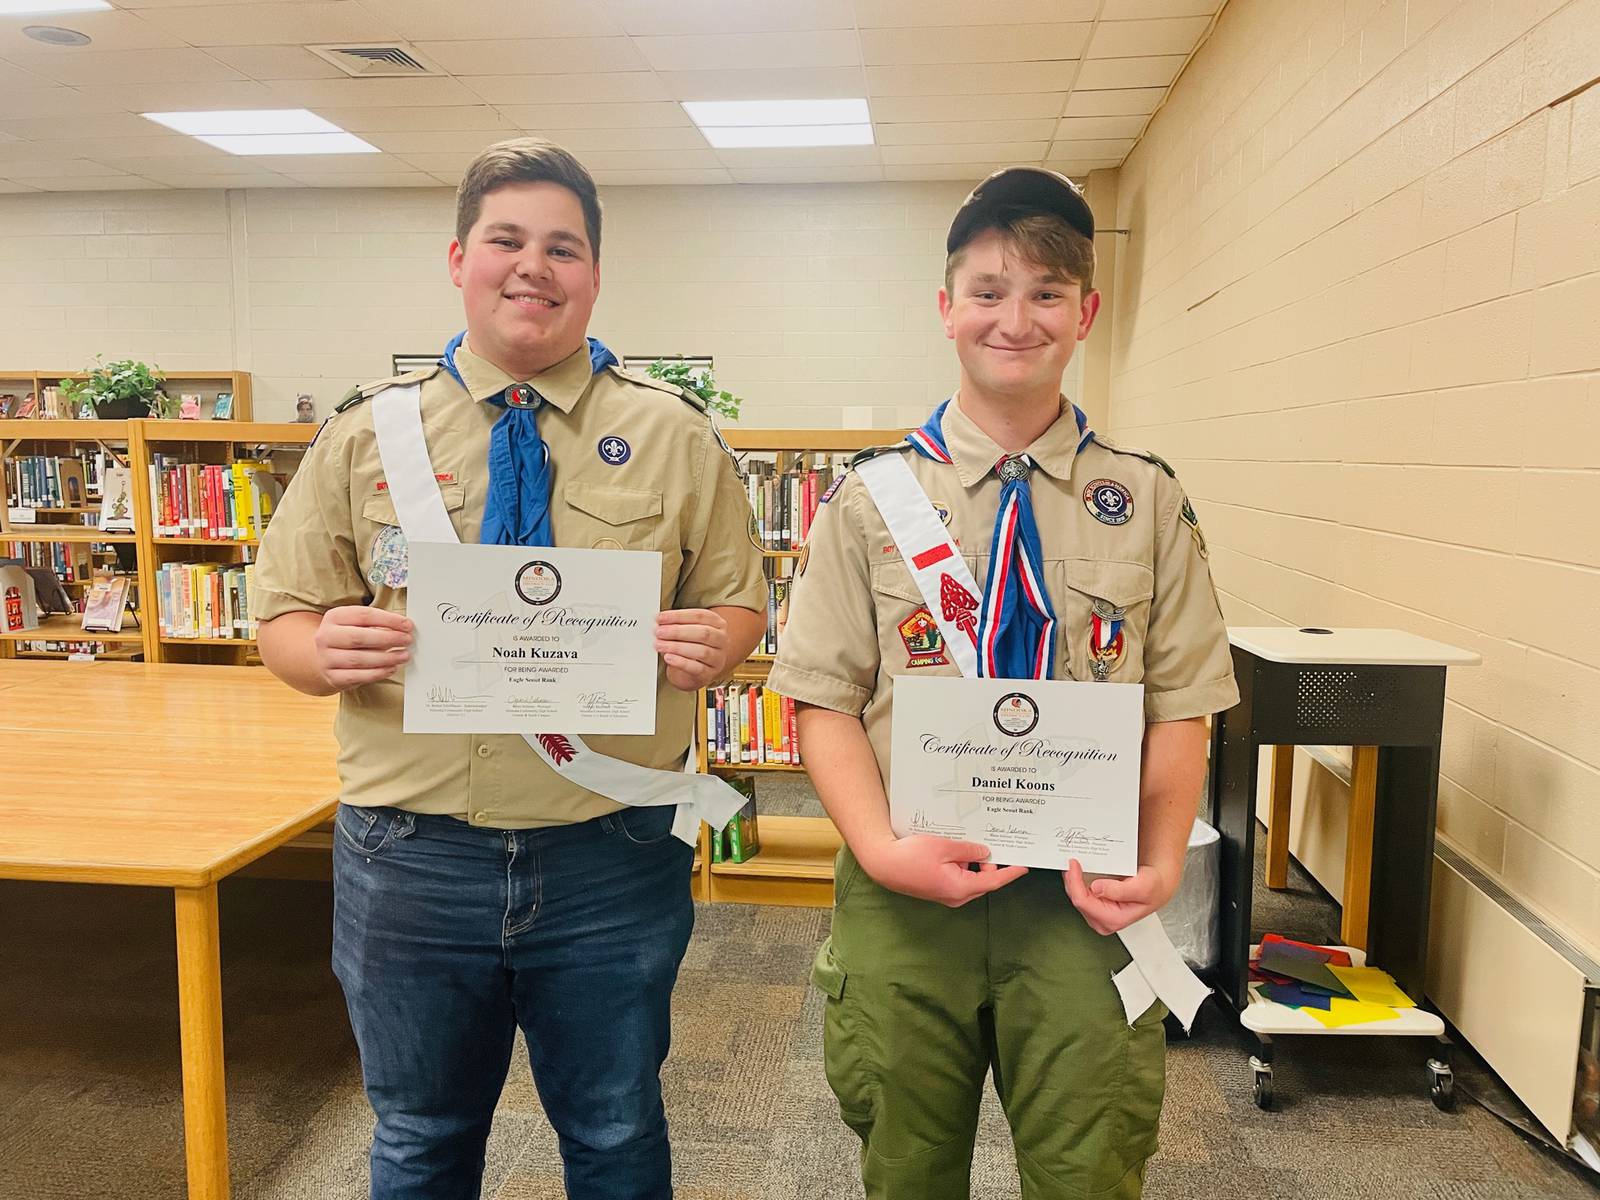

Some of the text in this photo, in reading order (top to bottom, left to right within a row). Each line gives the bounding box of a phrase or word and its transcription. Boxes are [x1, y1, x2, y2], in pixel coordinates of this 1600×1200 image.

[437, 602, 638, 634] Certificate of Recognition
[492, 646, 578, 659] Noah Kuzava
[517, 666, 537, 674] BEING
[920, 733, 1117, 766] Certificate of Recognition
[972, 776, 1055, 791] Daniel Koons
[995, 796, 1014, 804] BEING
